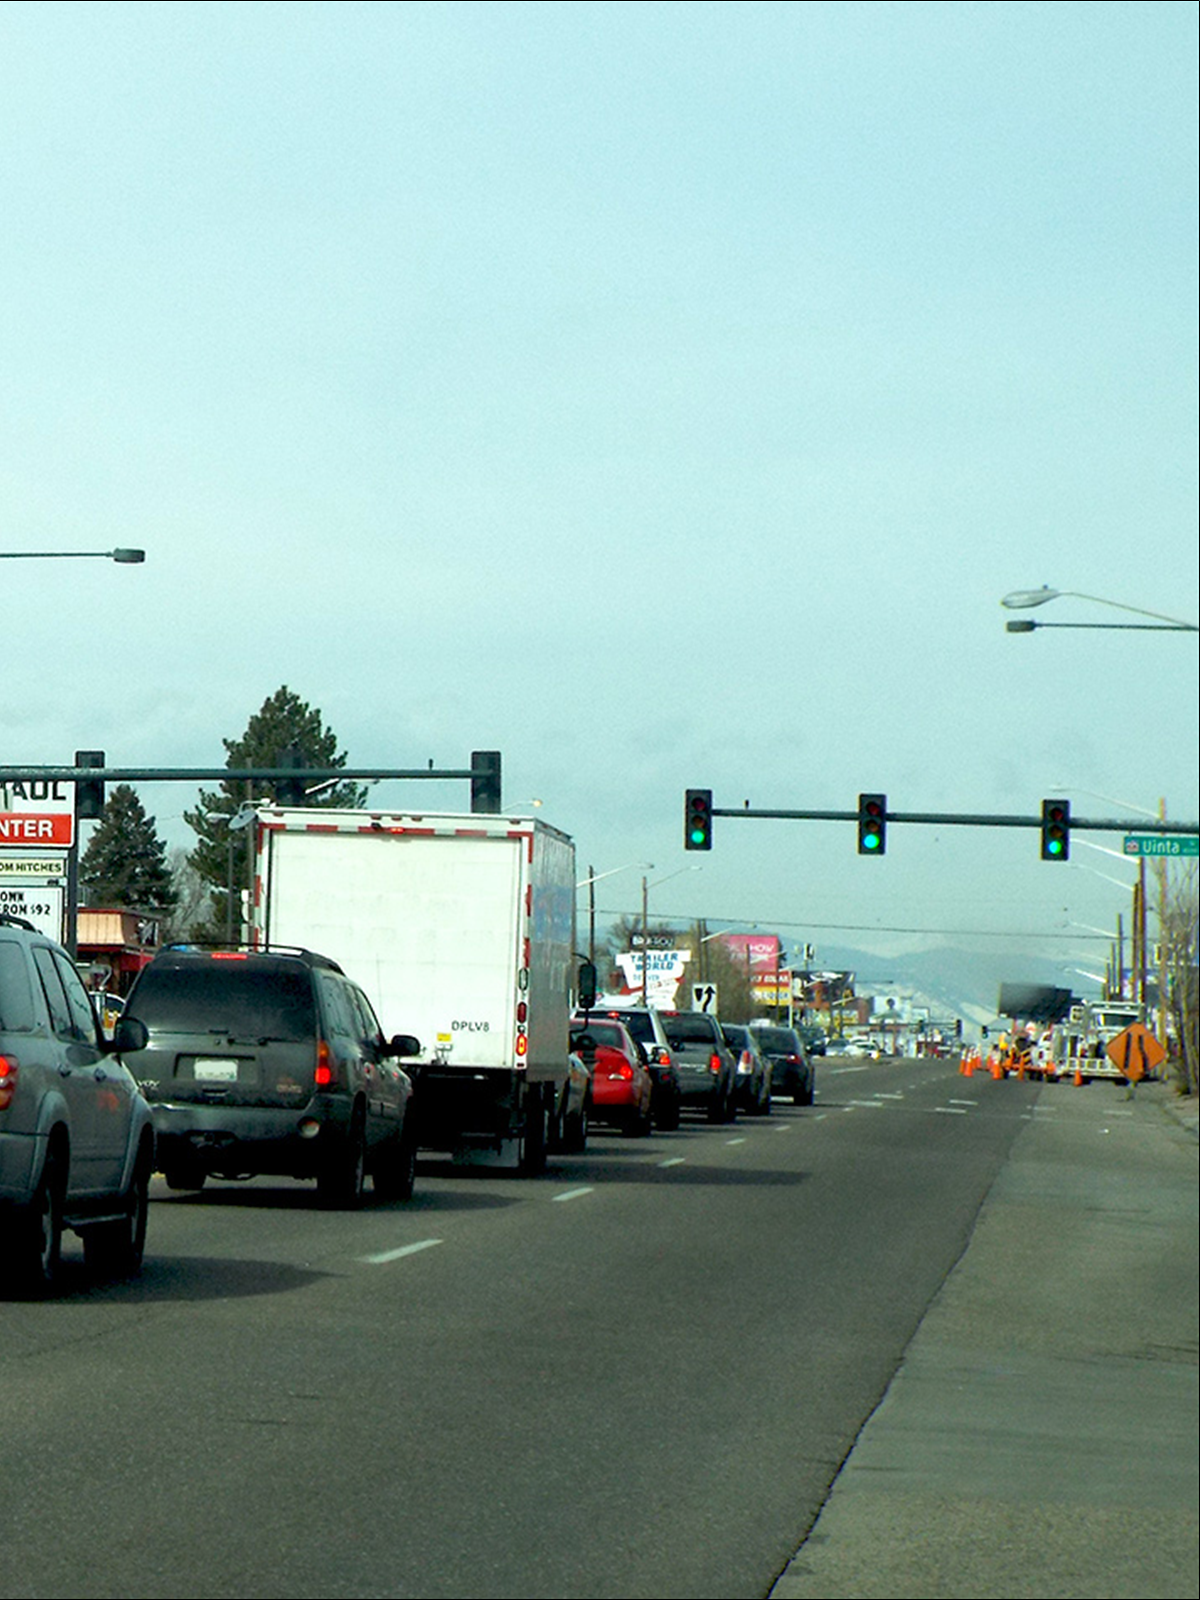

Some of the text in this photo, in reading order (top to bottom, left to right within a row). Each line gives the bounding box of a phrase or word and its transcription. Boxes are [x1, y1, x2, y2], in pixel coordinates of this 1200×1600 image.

[1142, 839, 1180, 854] Uinta
[15, 862, 62, 873] HITCHES
[30, 903, 51, 915] $92
[631, 952, 678, 962] TRAILER
[636, 961, 674, 971] WORLD
